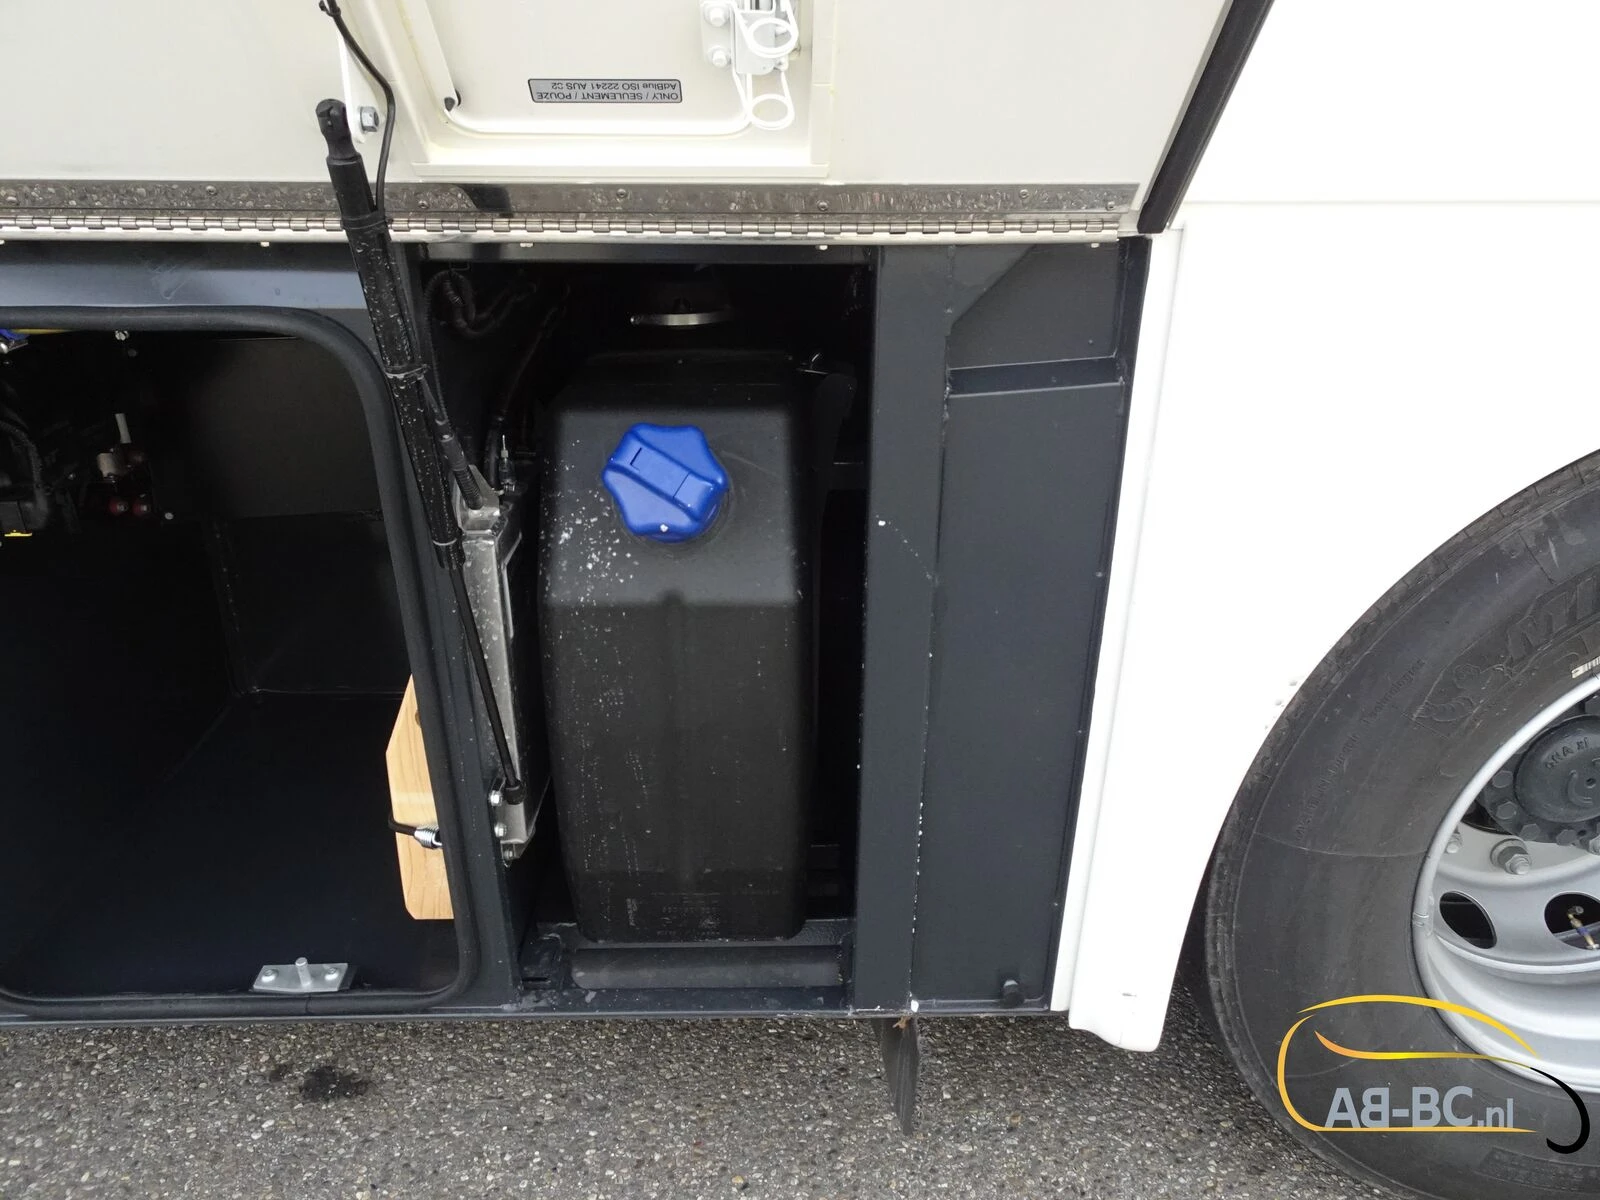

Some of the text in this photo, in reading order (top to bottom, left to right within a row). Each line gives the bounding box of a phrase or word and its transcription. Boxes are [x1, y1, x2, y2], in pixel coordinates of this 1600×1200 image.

[566, 82, 586, 90] AUS
[591, 82, 619, 90] 22241
[622, 82, 640, 90] ISO
[642, 82, 677, 90] AdBlue
[537, 92, 572, 100] POUZE
[581, 92, 643, 100] SEULEMENT
[651, 92, 679, 100] ONLY
